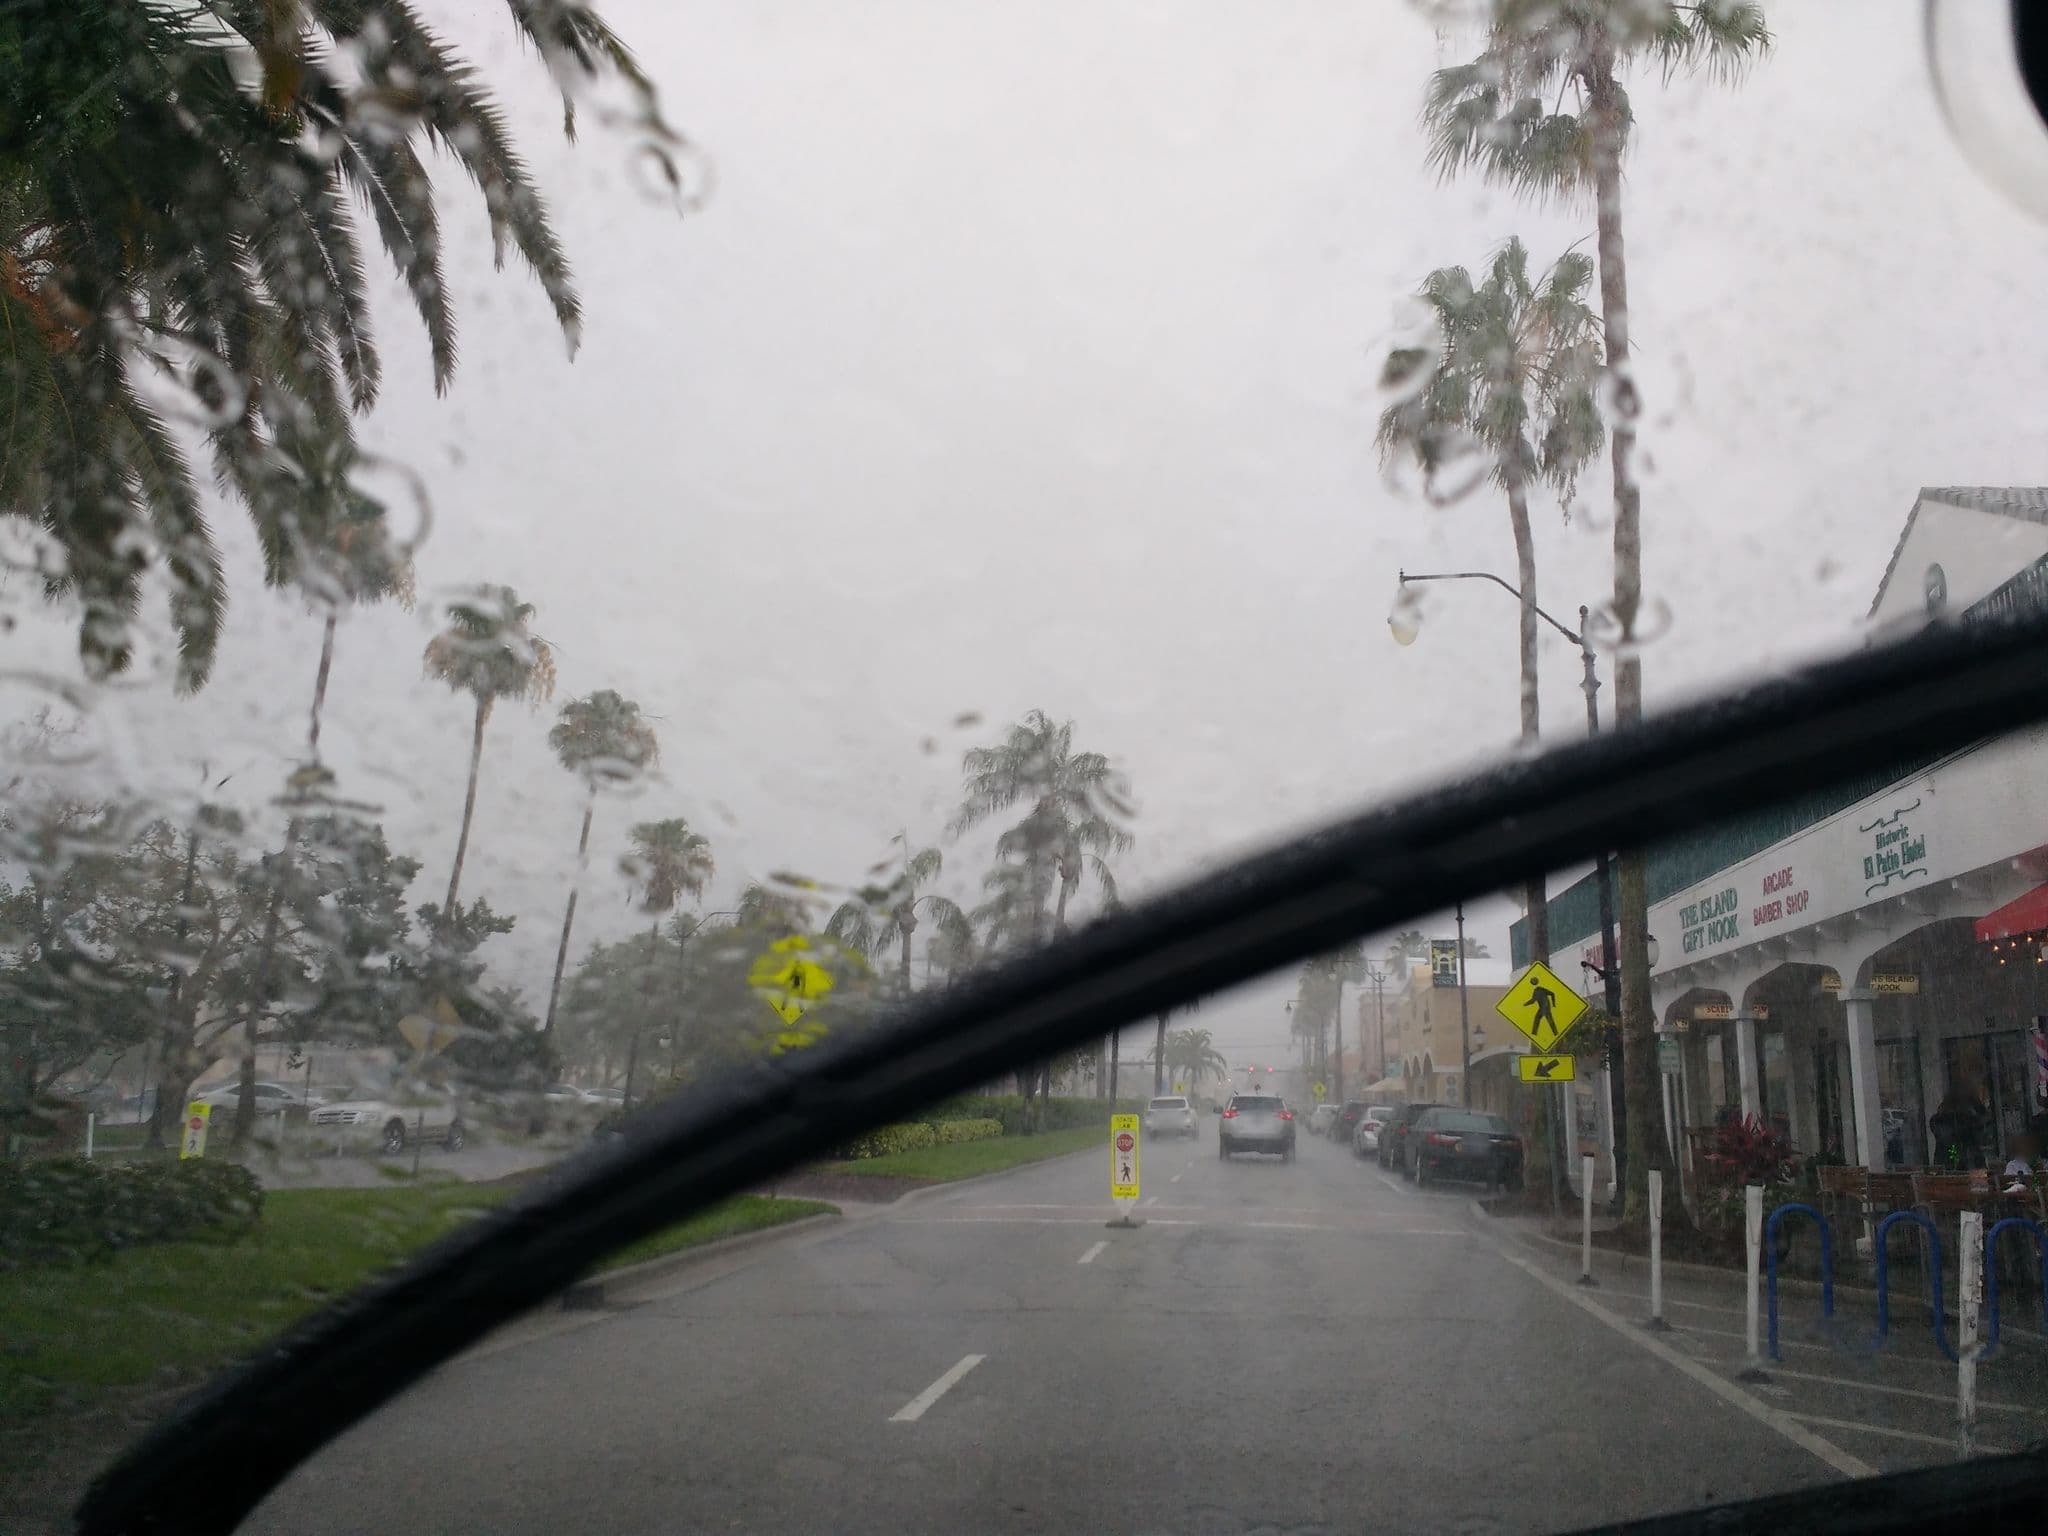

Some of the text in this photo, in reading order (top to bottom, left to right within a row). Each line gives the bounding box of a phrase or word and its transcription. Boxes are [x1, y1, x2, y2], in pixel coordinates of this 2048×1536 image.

[1875, 823, 1909, 850] Historic
[1863, 834, 1926, 879] El Patio Hotel
[1762, 866, 1793, 896] ARCADE
[1679, 887, 1738, 929] THE ISLAND
[1753, 889, 1809, 927] BARBER SHOP
[1682, 913, 1740, 953] GIFT NOOK
[1877, 983, 1901, 991] NOOK
[1885, 974, 1915, 983] ISLAND
[1117, 1138, 1133, 1148] STOP
